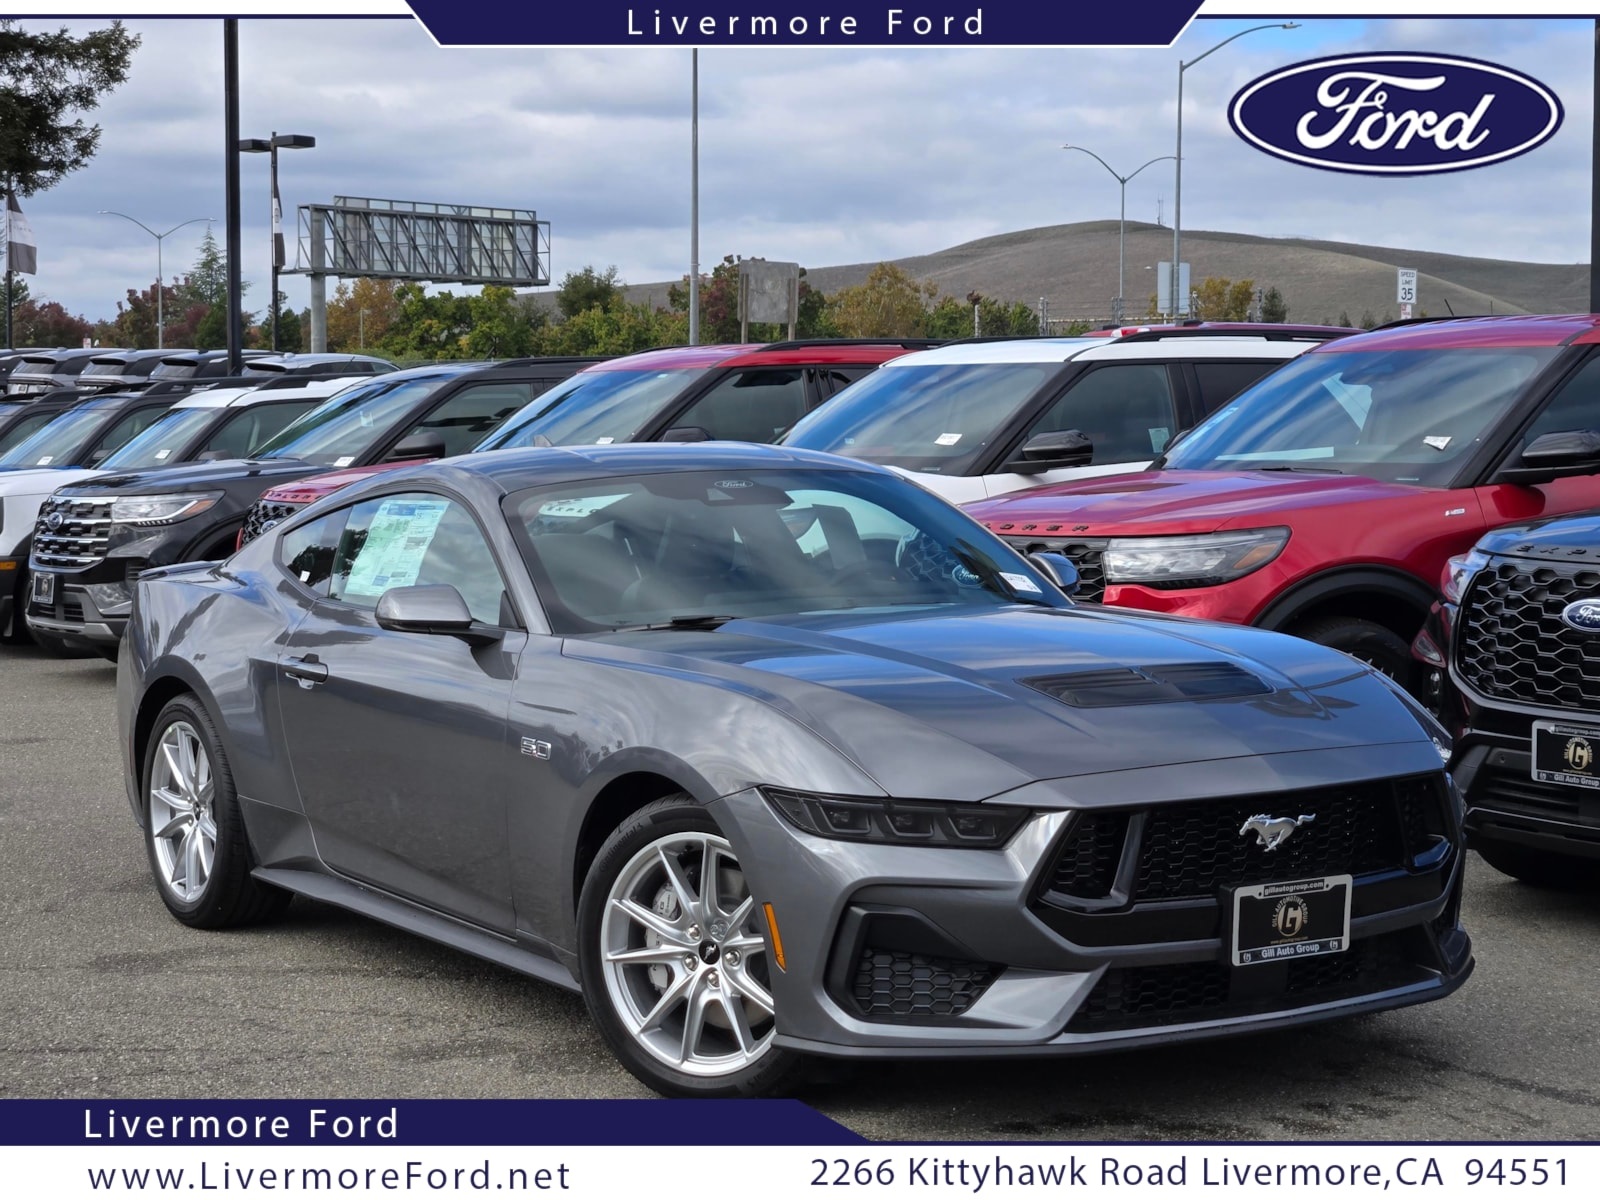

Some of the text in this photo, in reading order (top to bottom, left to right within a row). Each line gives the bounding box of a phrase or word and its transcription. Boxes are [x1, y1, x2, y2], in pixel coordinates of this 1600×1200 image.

[1401, 287, 1414, 301] 35
[1264, 880, 1324, 896] gillautogroup.com
[1261, 943, 1320, 959] Gill Auto Group
